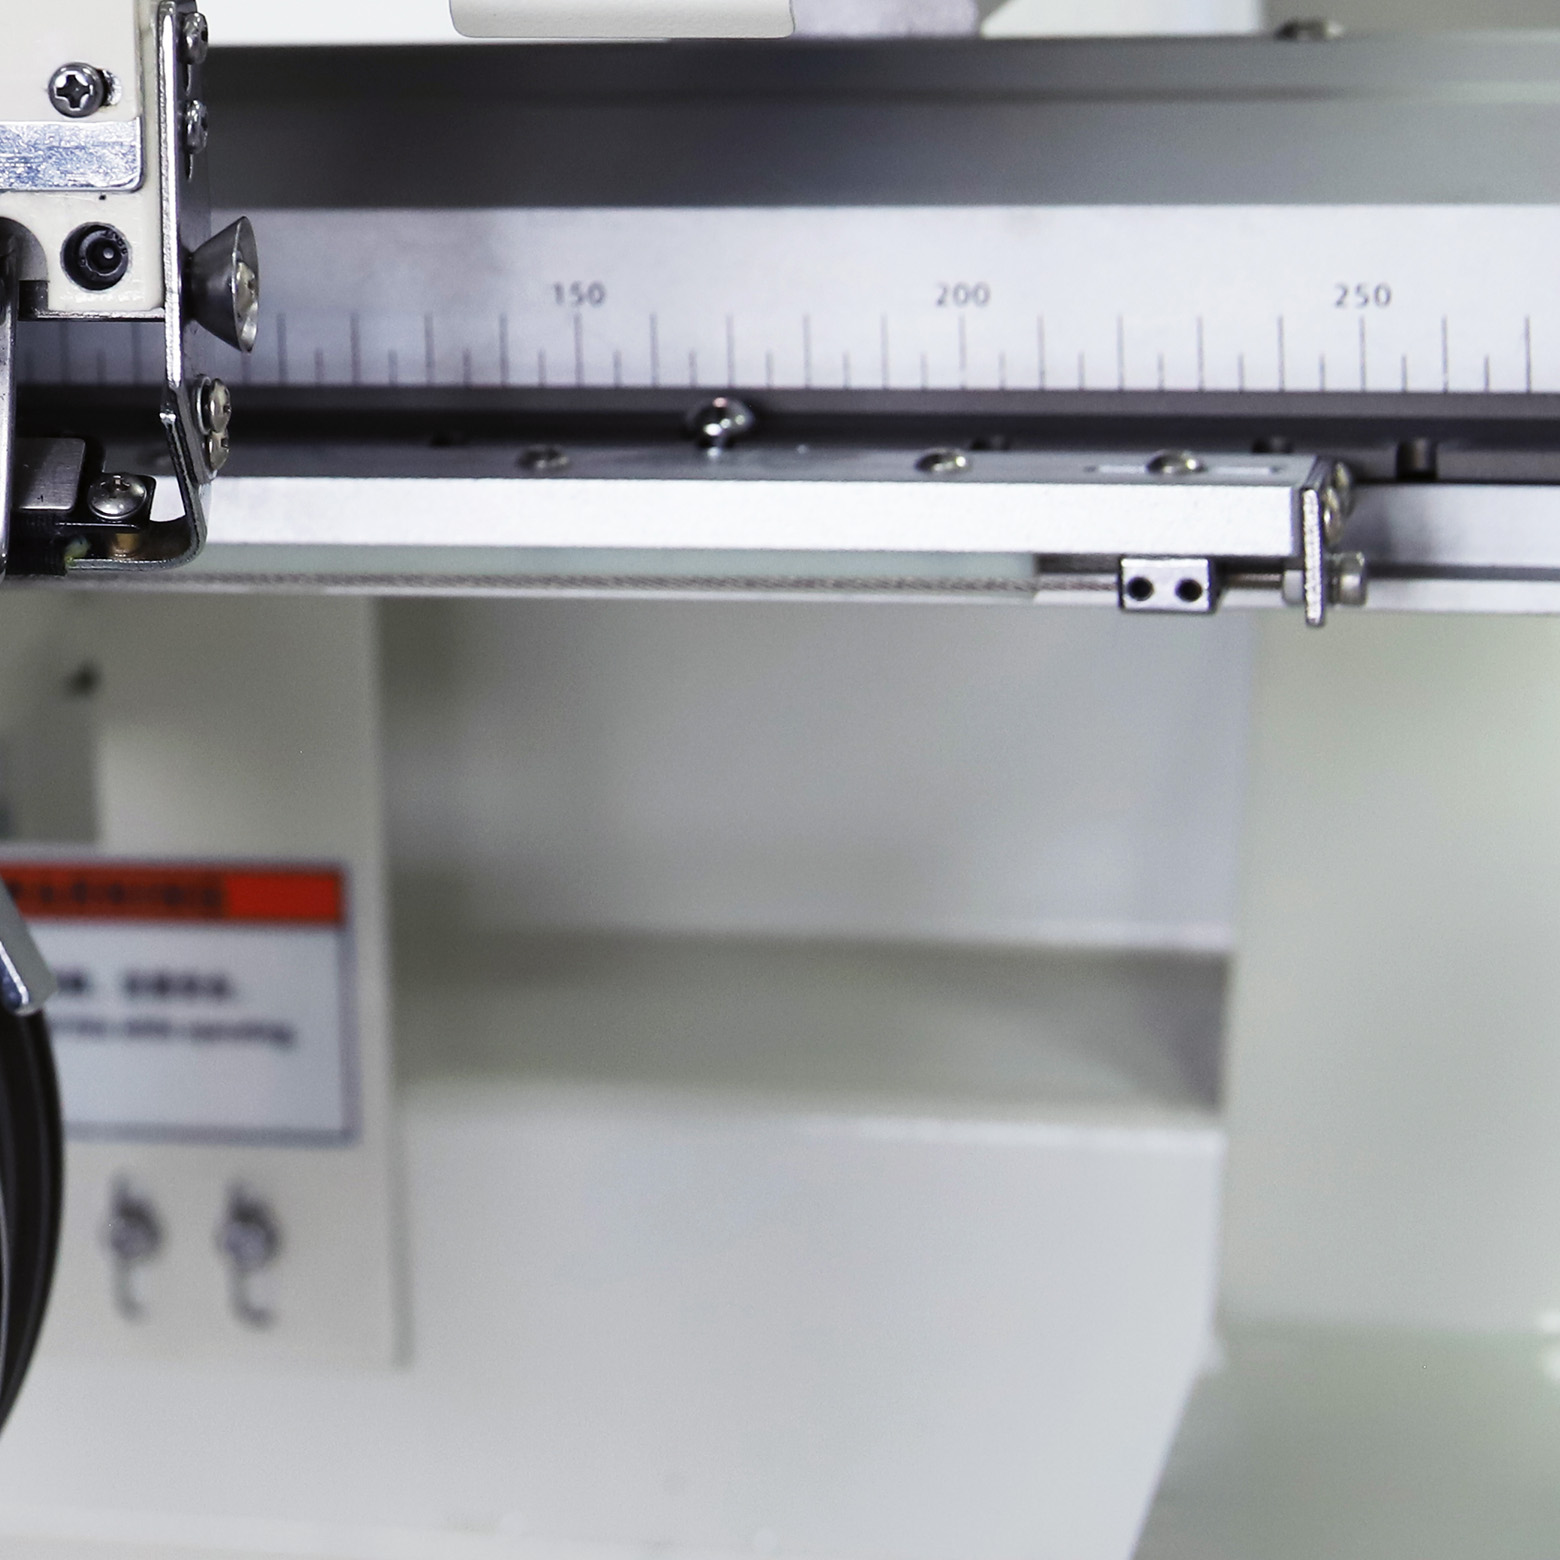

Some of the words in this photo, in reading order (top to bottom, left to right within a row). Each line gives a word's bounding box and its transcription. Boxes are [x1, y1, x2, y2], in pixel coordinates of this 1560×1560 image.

[553, 281, 607, 307] 150
[935, 281, 991, 308] 200
[1334, 282, 1391, 308] 250
